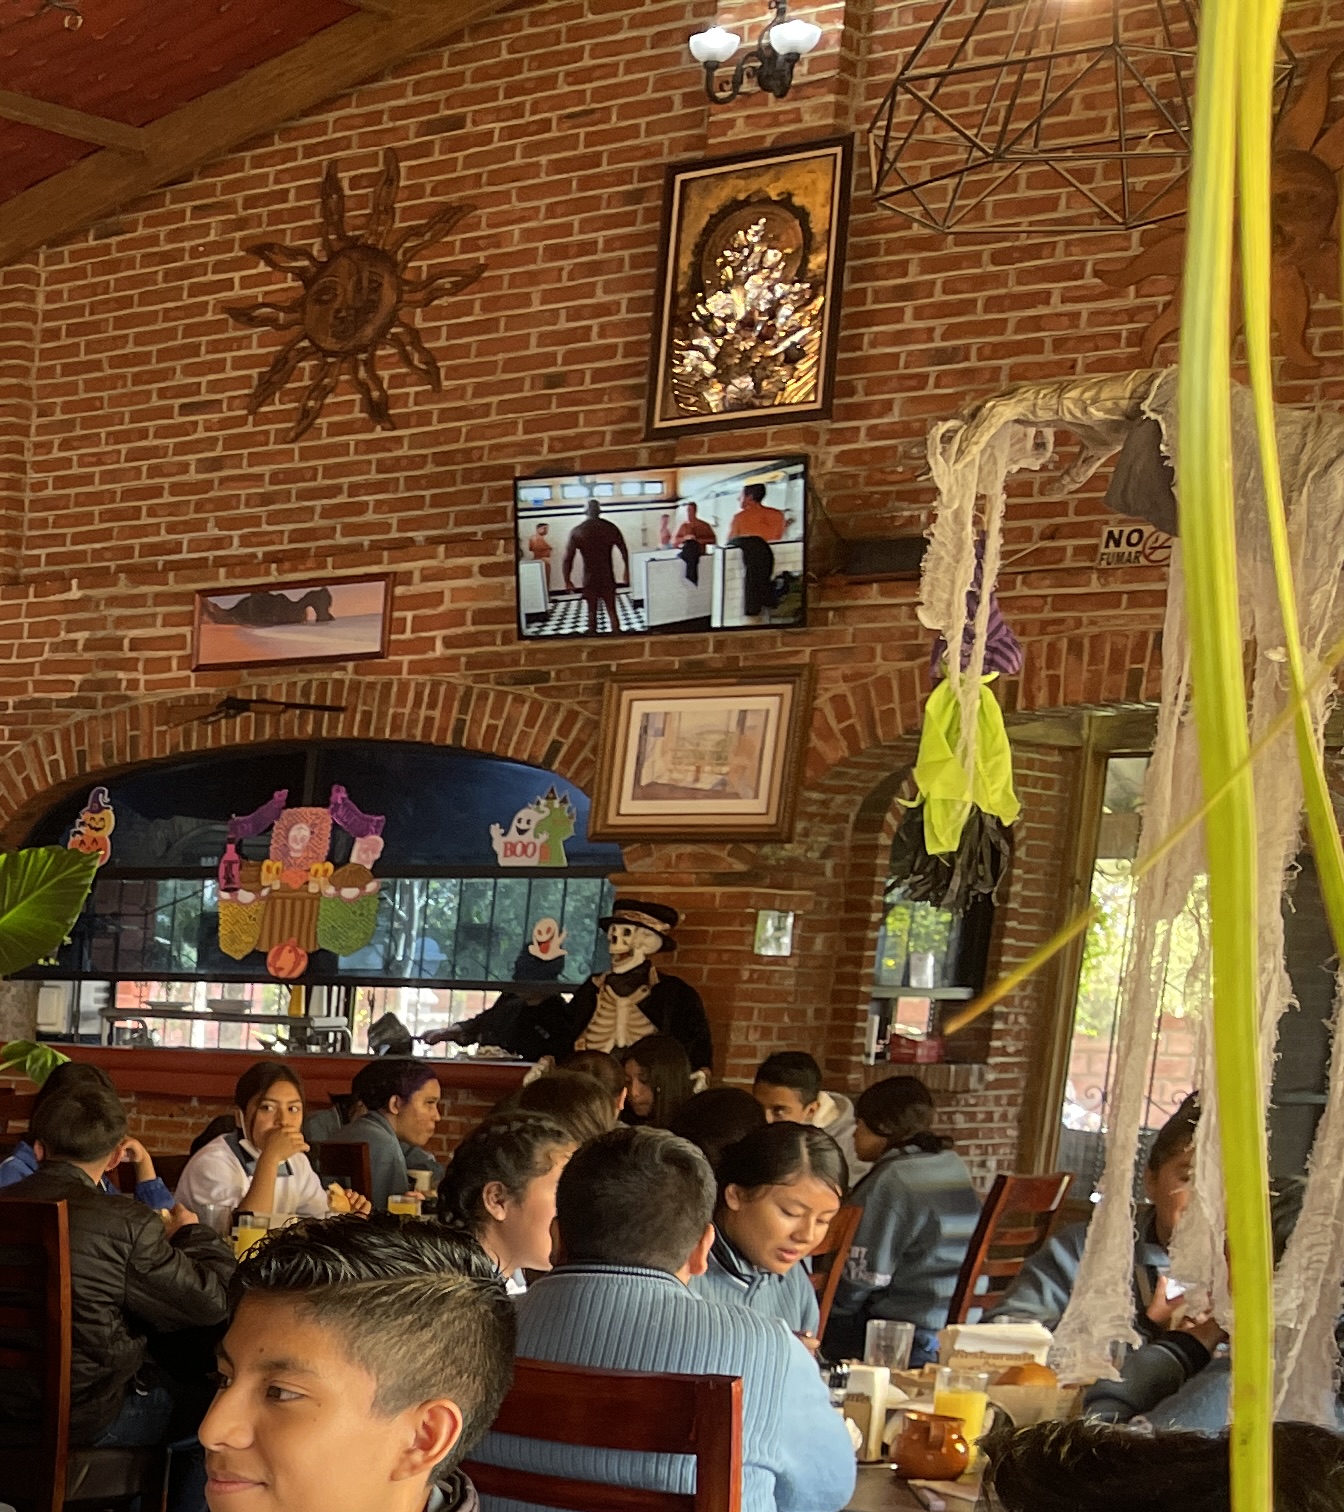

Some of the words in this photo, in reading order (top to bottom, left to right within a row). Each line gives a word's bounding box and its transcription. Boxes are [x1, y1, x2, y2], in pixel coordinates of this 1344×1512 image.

[1104, 528, 1144, 549] NO
[1100, 550, 1143, 567] FUMAR
[503, 841, 537, 858] BOO
